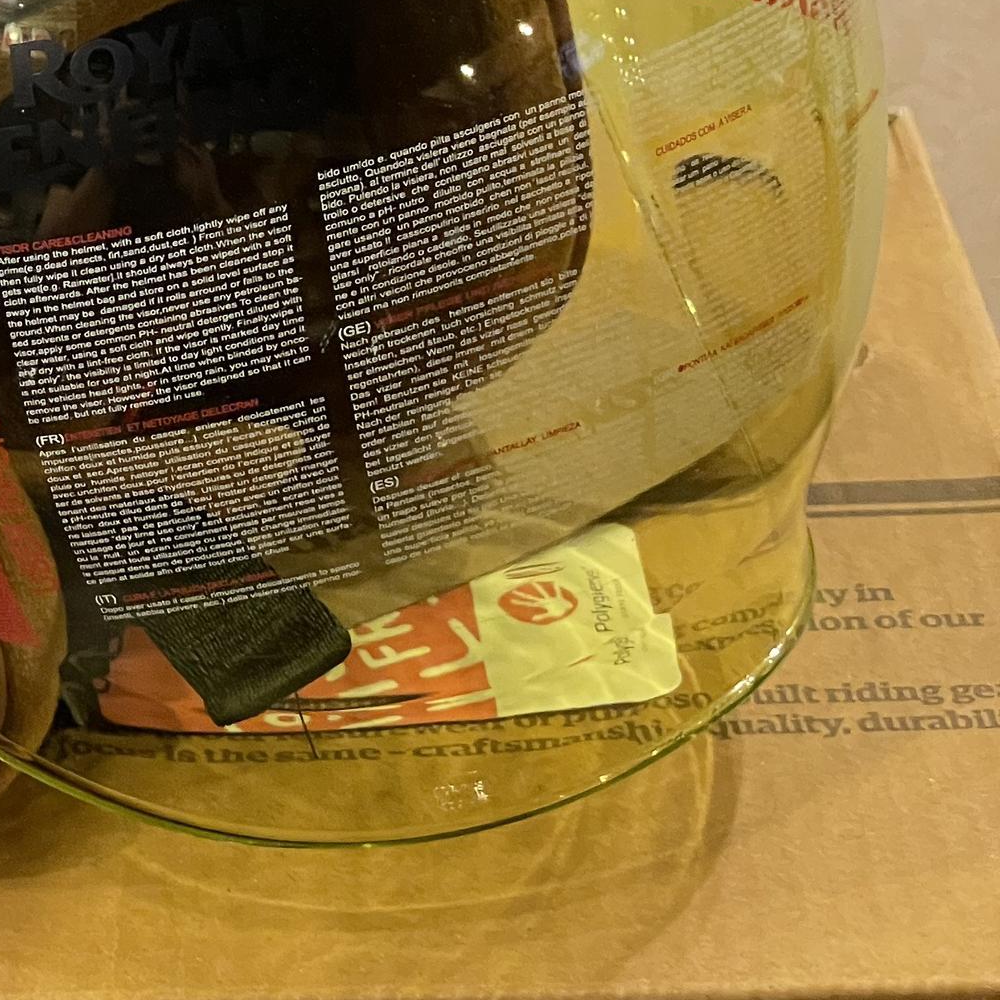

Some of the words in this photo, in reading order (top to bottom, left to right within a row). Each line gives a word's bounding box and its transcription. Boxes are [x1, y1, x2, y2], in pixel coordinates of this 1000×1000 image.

[22, 252, 50, 262] using
[51, 250, 68, 258] the
[110, 238, 132, 248] with
[144, 231, 164, 242] soft
[225, 213, 250, 224] wipe
[252, 207, 266, 217] off
[268, 203, 287, 214] any
[0, 278, 21, 286] then
[23, 274, 43, 283] fully
[45, 271, 69, 281] wipe
[79, 265, 107, 275] clean
[109, 259, 137, 270] using
[148, 254, 165, 263] dry
[167, 248, 186, 259] soft
[248, 231, 265, 241] the
[267, 224, 292, 236] visor
[3, 297, 27, 307] cloth
[85, 285, 110, 295] After
[112, 282, 128, 290] the
[131, 273, 166, 287] helmet
[168, 270, 188, 280] has
[190, 264, 216, 275] been
[219, 252, 259, 268] cleaned
[262, 247, 284, 258] stop
[5, 309, 30, 317] away
[43, 304, 59, 313] the
[60, 298, 94, 310] helmet
[96, 295, 115, 304] bag
[117, 290, 137, 301] and
[138, 286, 164, 296] store
[166, 283, 180, 291] on
[191, 274, 214, 286] solid
[216, 268, 240, 280] level
[242, 260, 279, 274] surface
[282, 256, 294, 264] as
[338, 321, 372, 341] (GE)
[25, 406, 60, 415] remove
[62, 403, 78, 411] the
[155, 387, 171, 395] the
[173, 381, 198, 391] visor
[199, 369, 245, 386] designed
[247, 368, 260, 376] so
[261, 361, 282, 372] that
[292, 355, 311, 364] can
[35, 433, 66, 450] (FR)
[370, 476, 400, 494] (ES)
[95, 594, 117, 607] (IT)
[855, 583, 896, 602] in
[874, 609, 913, 630] of
[919, 611, 985, 628] our
[752, 684, 820, 705] uilt
[824, 682, 944, 706] riding
